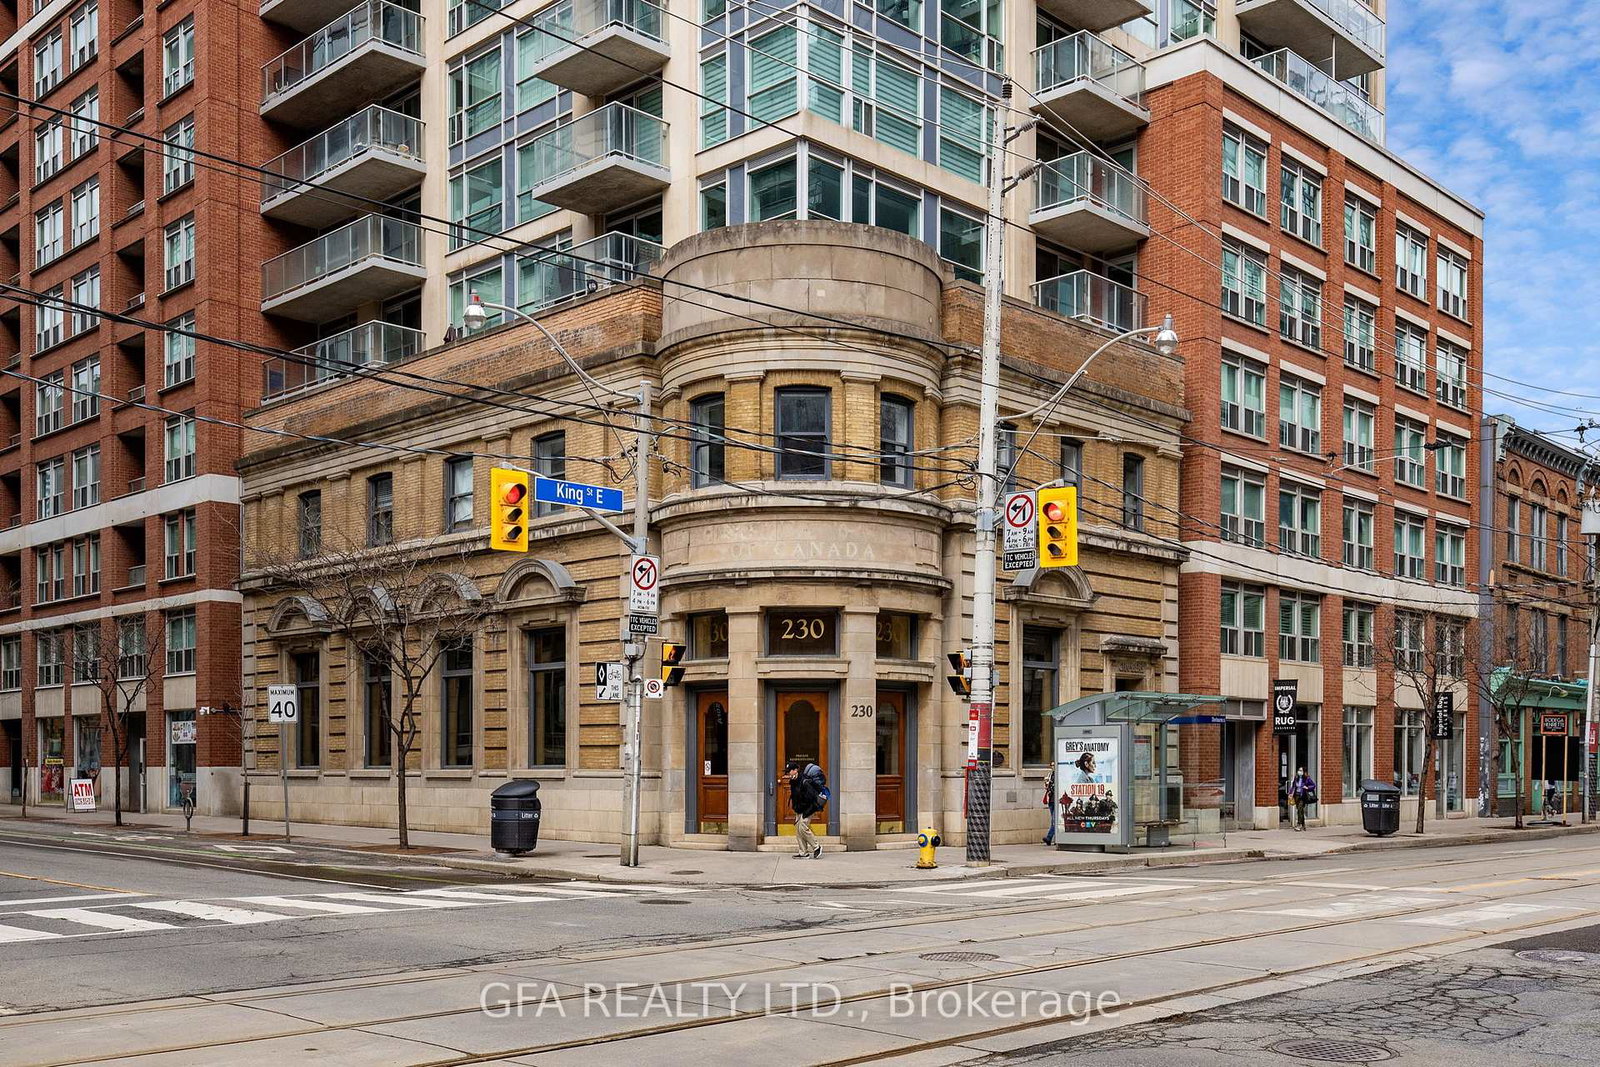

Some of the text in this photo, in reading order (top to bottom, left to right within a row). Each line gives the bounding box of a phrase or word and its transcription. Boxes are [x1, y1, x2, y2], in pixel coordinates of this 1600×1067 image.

[556, 482, 603, 505] King St E
[775, 541, 876, 560] CANADA
[1014, 552, 1034, 560] VEHICLES
[1005, 561, 1034, 569] EXCEPTED
[630, 624, 656, 632] EXCEPTED
[781, 618, 825, 639] 230
[271, 701, 296, 718] 40
[851, 705, 873, 718] 230
[1275, 717, 1295, 725] RUG
[1436, 709, 1444, 737] Imperial
[1065, 741, 1109, 752] GREY'S ANATOMY
[74, 783, 93, 797] ATM
[1071, 783, 1105, 795] STATION 19
